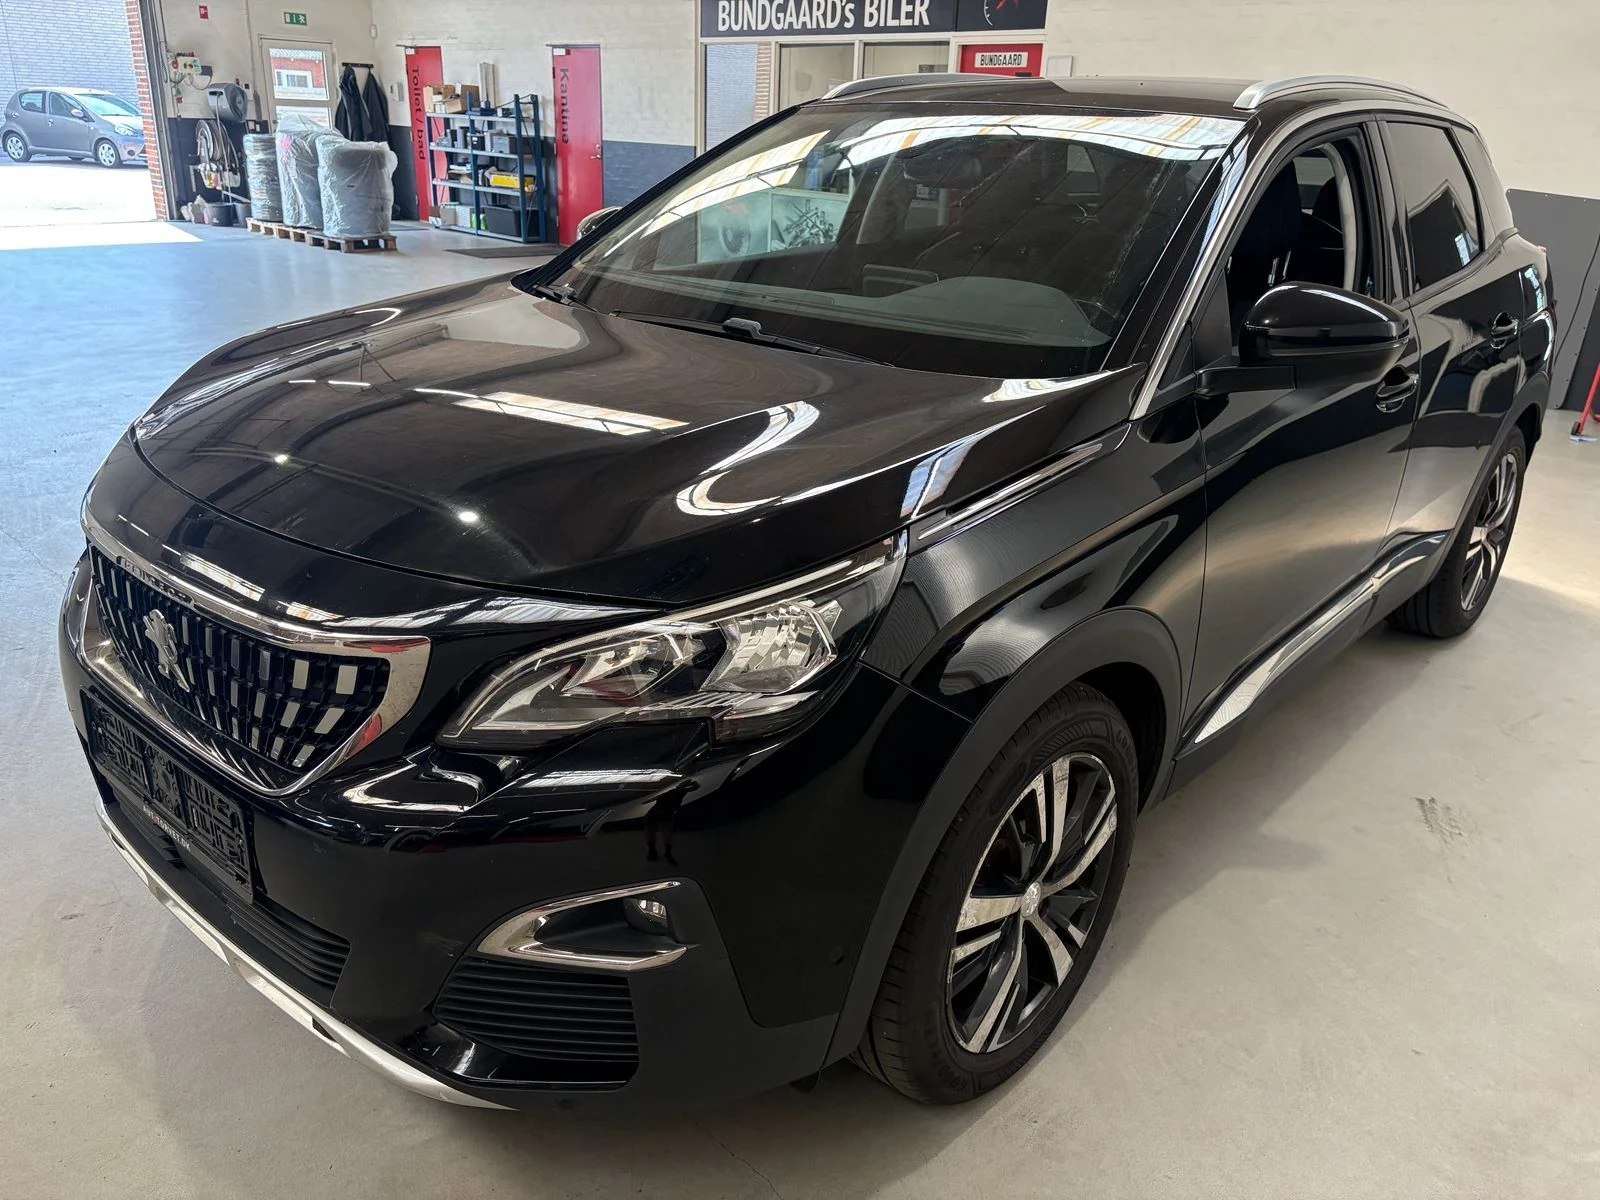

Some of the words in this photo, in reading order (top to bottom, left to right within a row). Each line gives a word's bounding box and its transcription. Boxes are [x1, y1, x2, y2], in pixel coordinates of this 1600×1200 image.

[718, 0, 855, 31] BUNDGAARD's
[863, 0, 930, 28] BILER
[980, 54, 1022, 66] BUNDGAARD
[412, 66, 422, 113] Toilet
[417, 129, 426, 160] bad
[560, 68, 570, 144] Kantine
